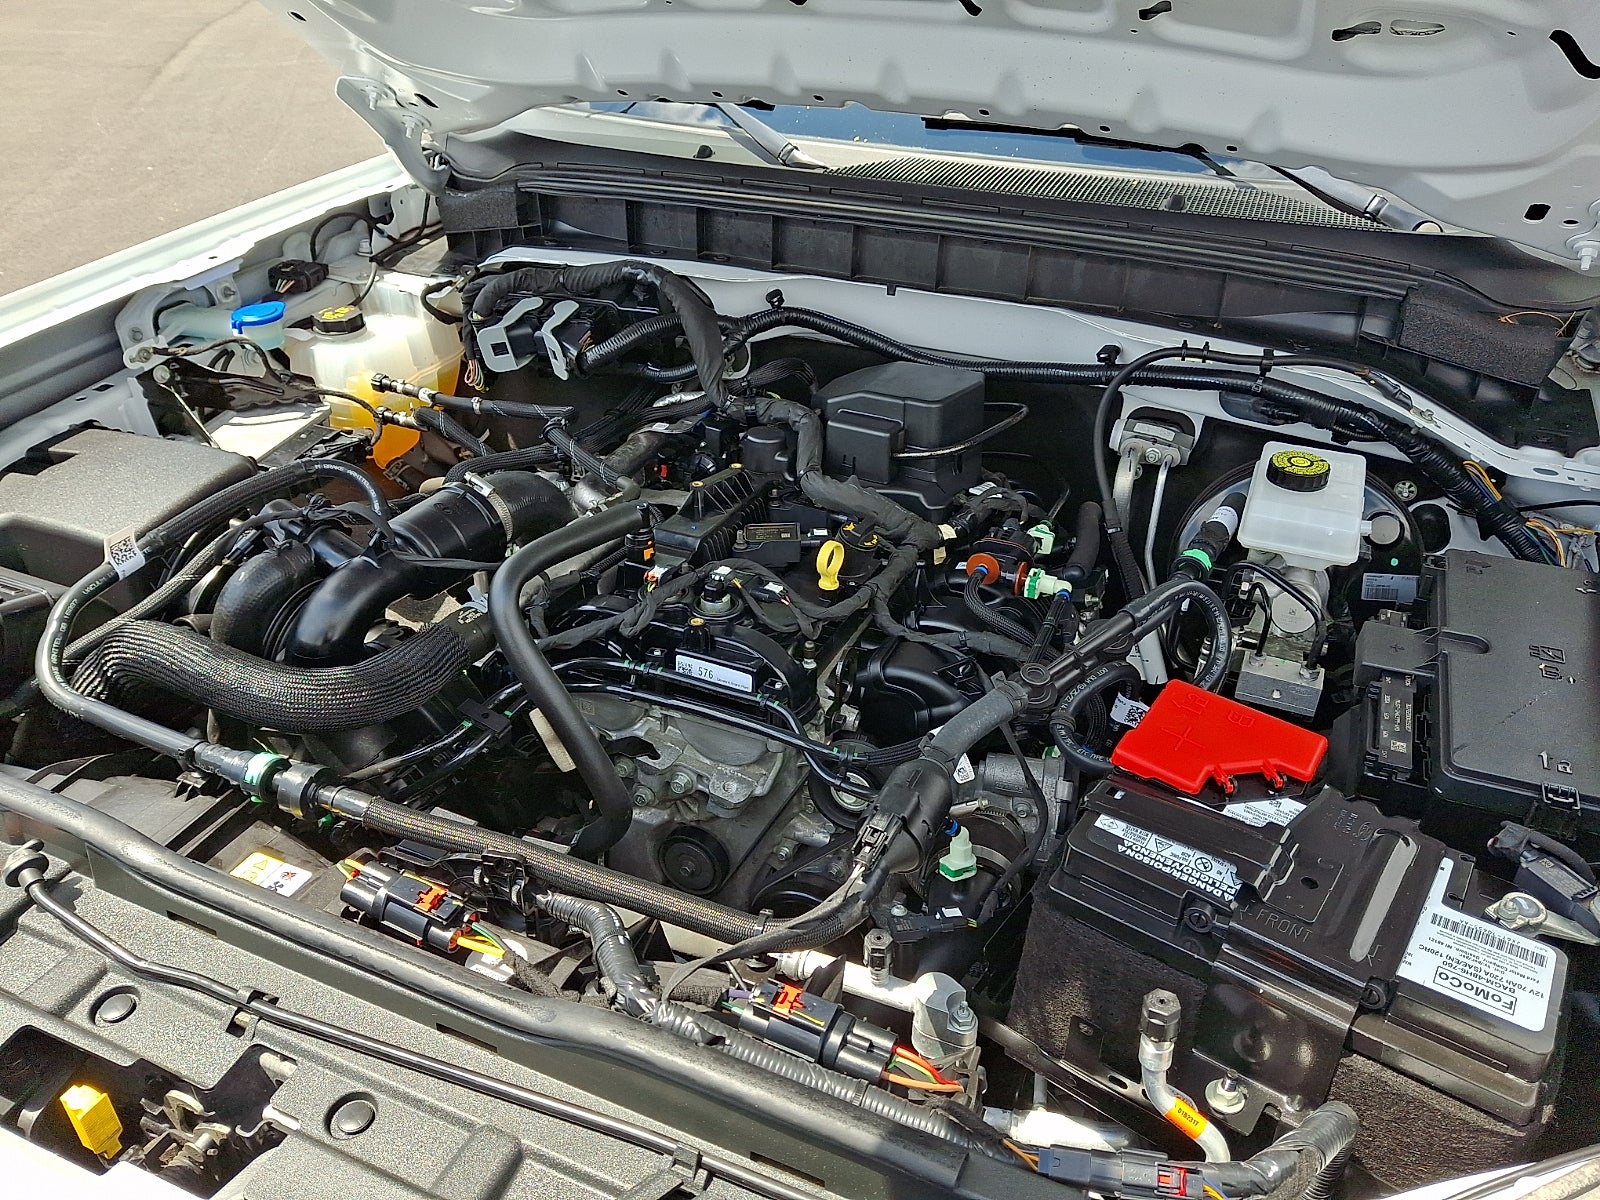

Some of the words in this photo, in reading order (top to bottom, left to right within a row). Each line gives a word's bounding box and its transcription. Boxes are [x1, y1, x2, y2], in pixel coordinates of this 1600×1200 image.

[699, 666, 713, 679] 576
[1124, 847, 1222, 896] DANGER/POISON
[1130, 843, 1236, 894] PELIGRO/VENENO
[1255, 908, 1313, 944] FRONT
[1417, 943, 1444, 958] 120RC
[1444, 953, 1482, 974] (SAE/EN)
[1482, 969, 1504, 982] 720A
[1505, 978, 1527, 991] 70Ah
[1436, 970, 1514, 1010] FoMoCo
[1528, 988, 1545, 998] 12V
